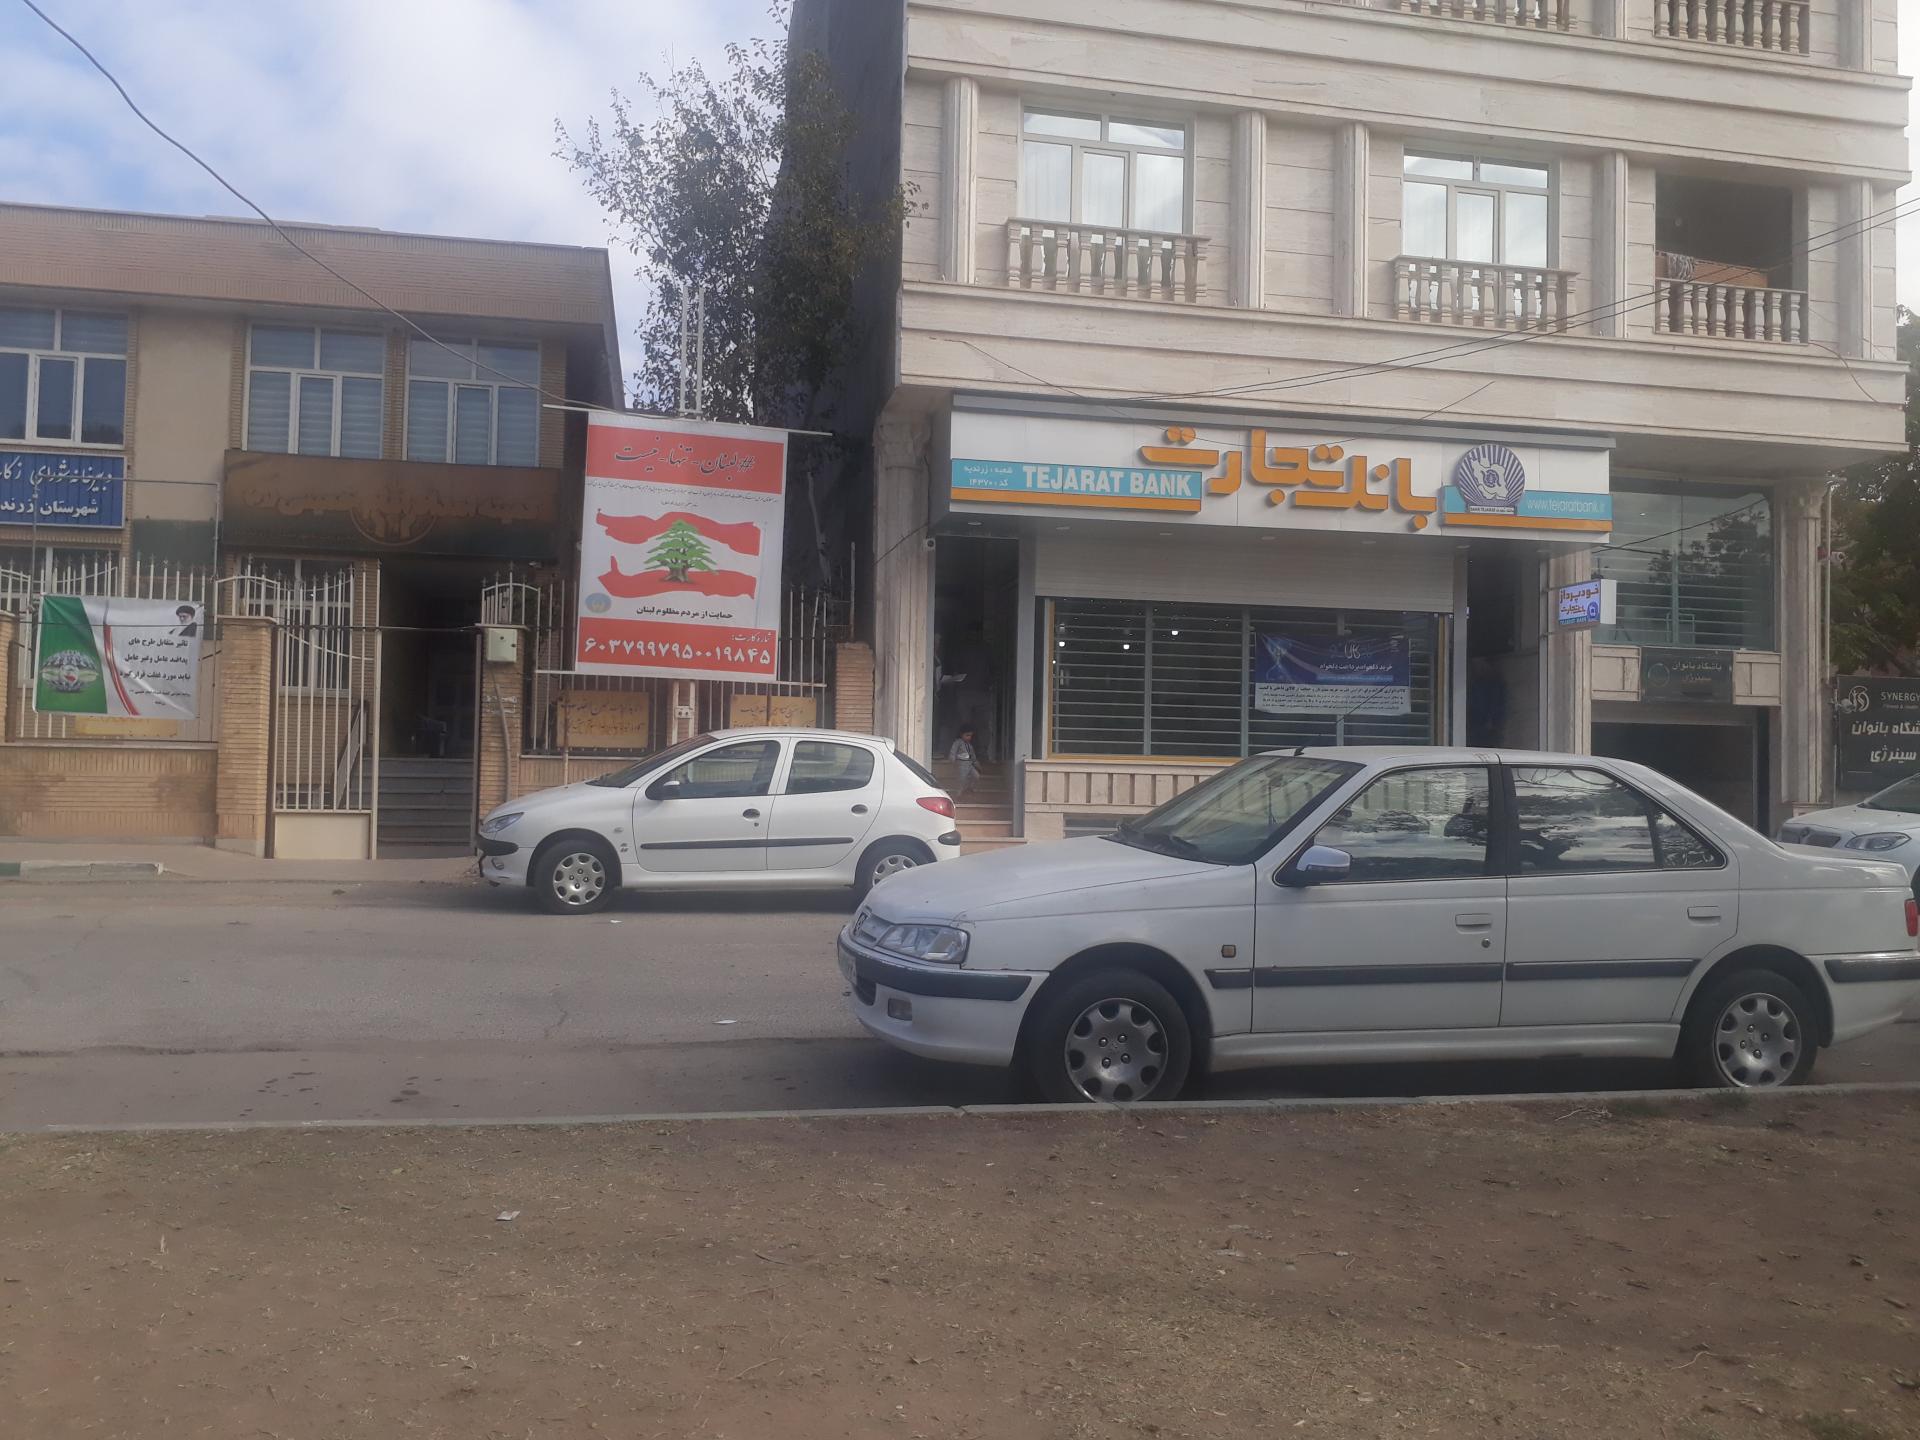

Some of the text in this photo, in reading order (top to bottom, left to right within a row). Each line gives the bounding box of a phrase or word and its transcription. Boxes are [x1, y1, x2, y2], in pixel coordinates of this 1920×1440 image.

[1023, 465, 1192, 497] TEJARAT BANK
[1140, 426, 1437, 530] بانک تجارت
[40, 499, 98, 517] شهرستان
[1560, 584, 1600, 604] خودپرداز
[636, 605, 733, 620] حمایت از مردم مظلوم لبنان
[584, 637, 771, 665] ۶۰۳۷۹۹۷۹۵۰۰۱۹۸۴۵
[1880, 691, 1920, 702] SYNERGY
[1851, 719, 1889, 737] بانوان
[1870, 744, 1917, 764] سینرژی
